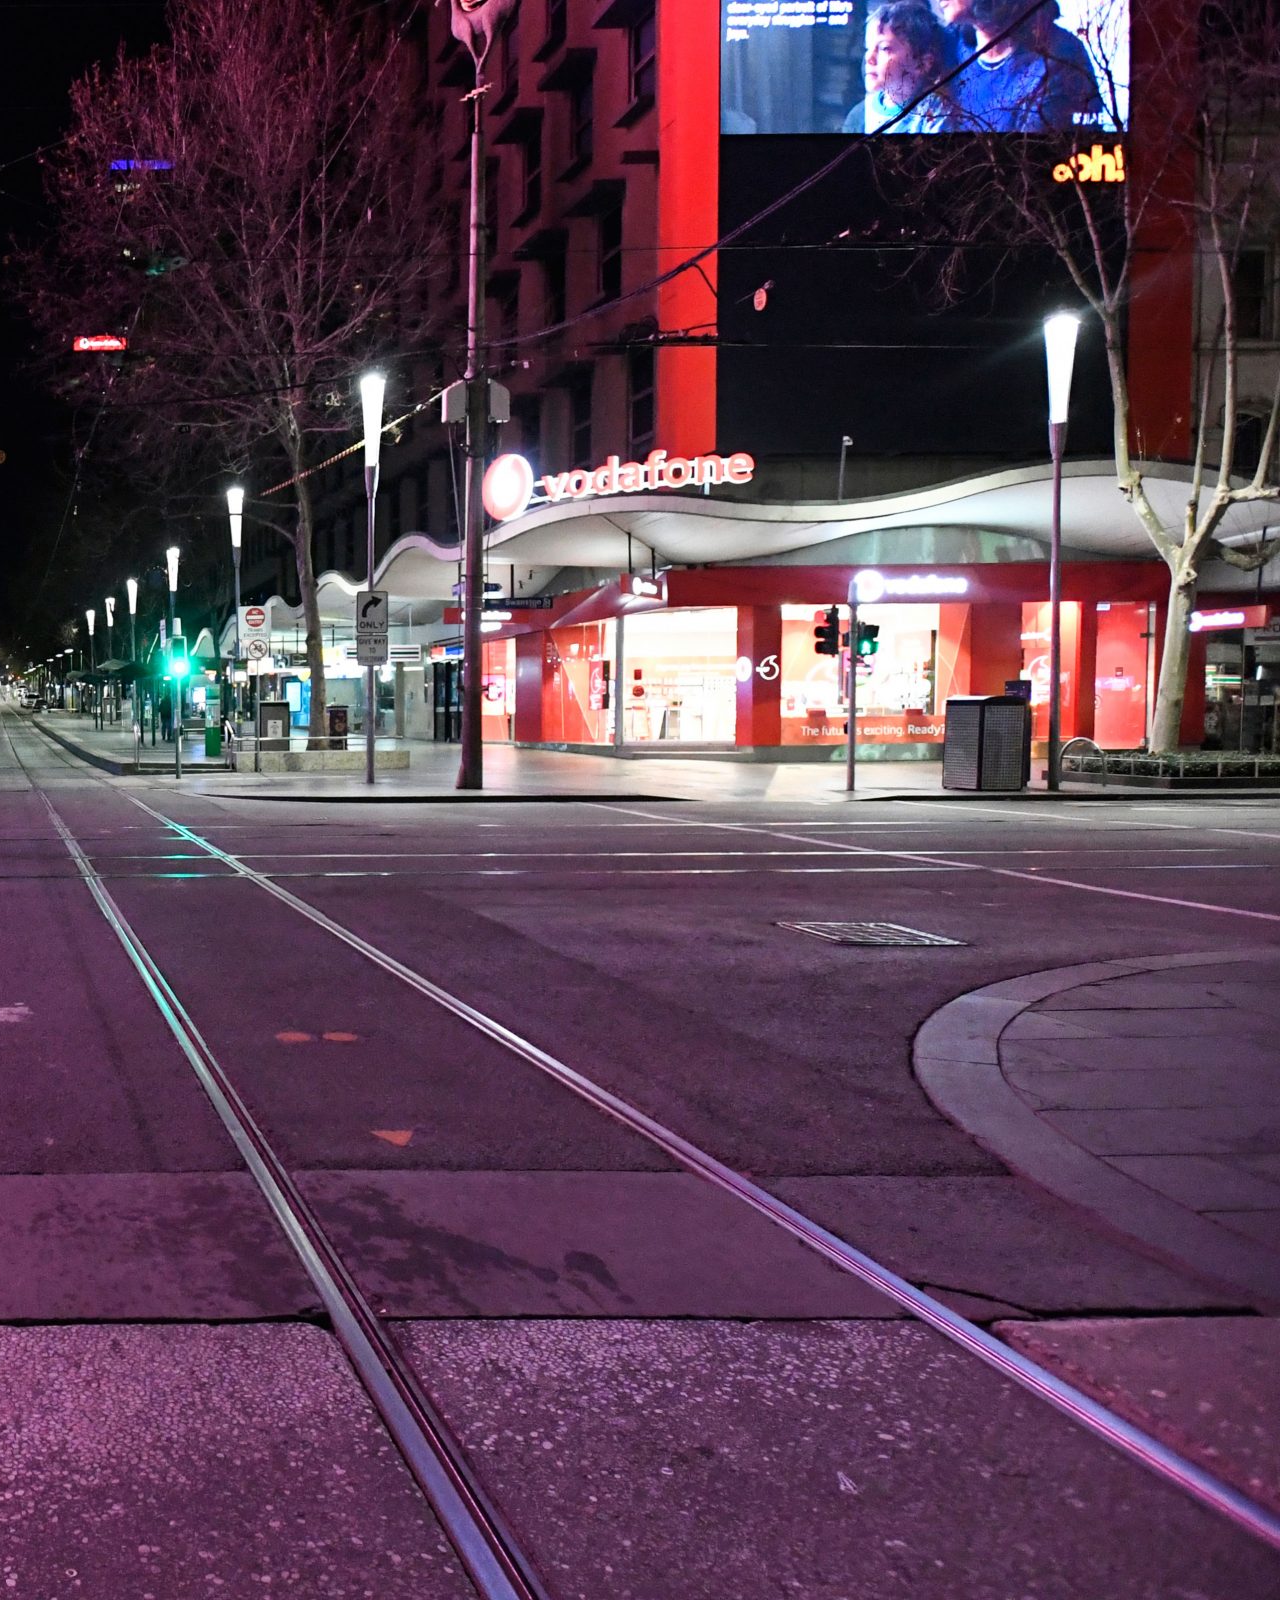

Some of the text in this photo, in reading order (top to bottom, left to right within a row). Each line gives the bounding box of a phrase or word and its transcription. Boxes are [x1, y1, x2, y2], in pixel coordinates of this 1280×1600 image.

[542, 449, 755, 502] vodafone
[359, 621, 385, 629] ONLY
[801, 726, 819, 737] The
[821, 725, 847, 737] futu
[863, 726, 905, 738] exciting.
[907, 724, 945, 737] Ready?
